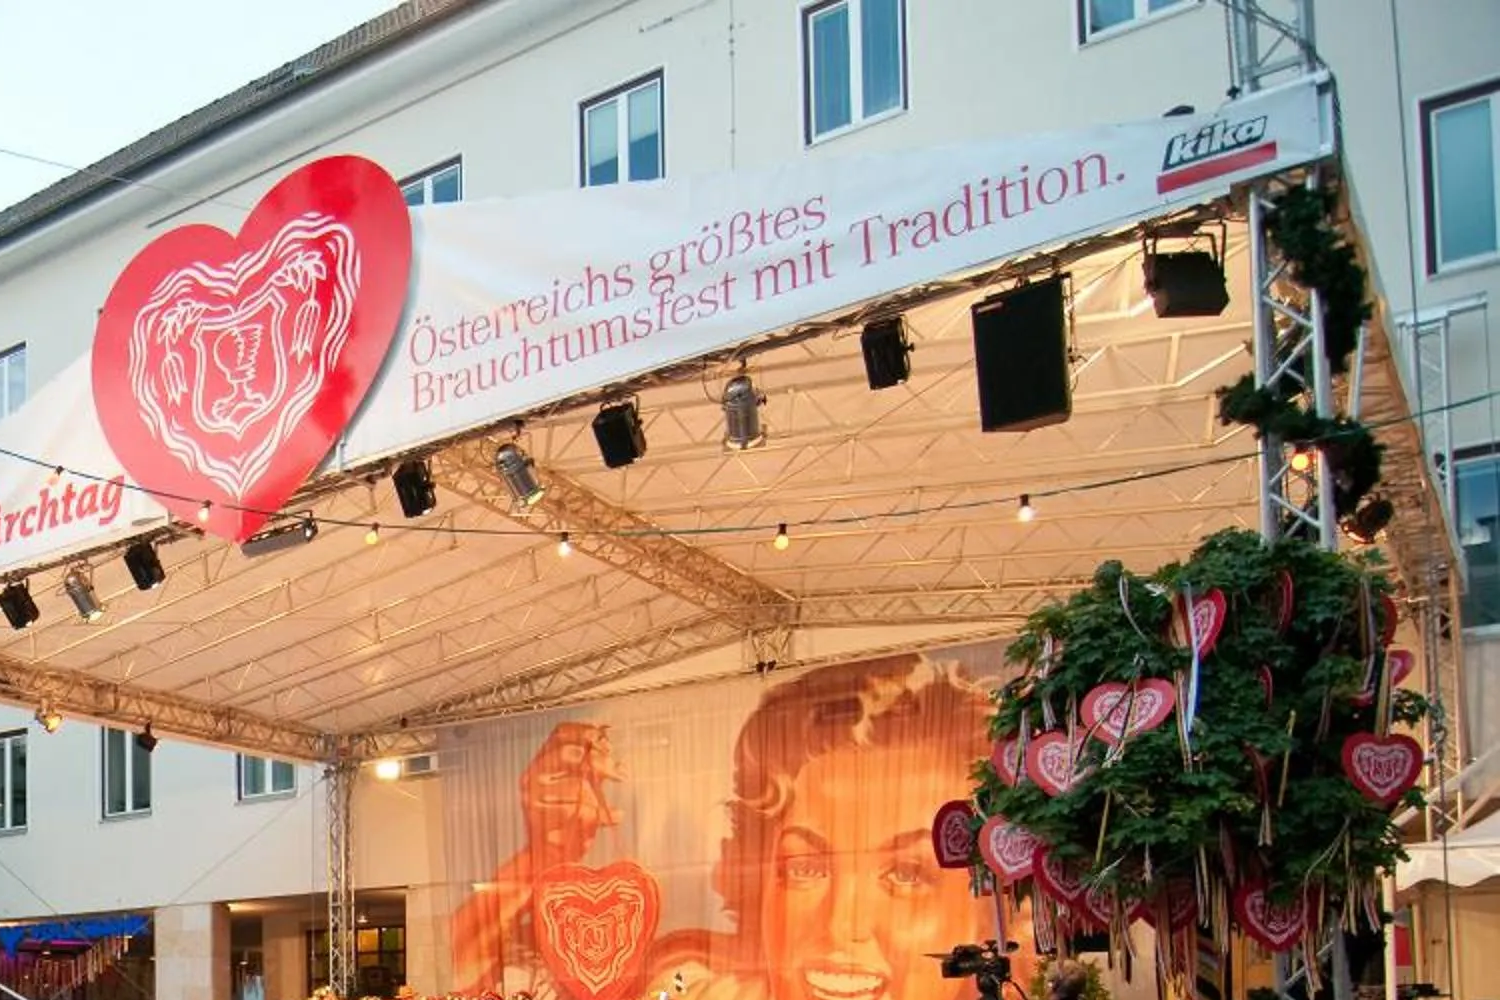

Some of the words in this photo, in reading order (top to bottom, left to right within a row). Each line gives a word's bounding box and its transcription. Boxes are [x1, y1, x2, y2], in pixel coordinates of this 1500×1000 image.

[1163, 116, 1268, 171] kika
[410, 264, 634, 367] Österreichs
[648, 194, 828, 293] größtes
[412, 272, 738, 413] Brauchtumsfest
[752, 240, 835, 300] mit
[849, 152, 1126, 267] Tradition.
